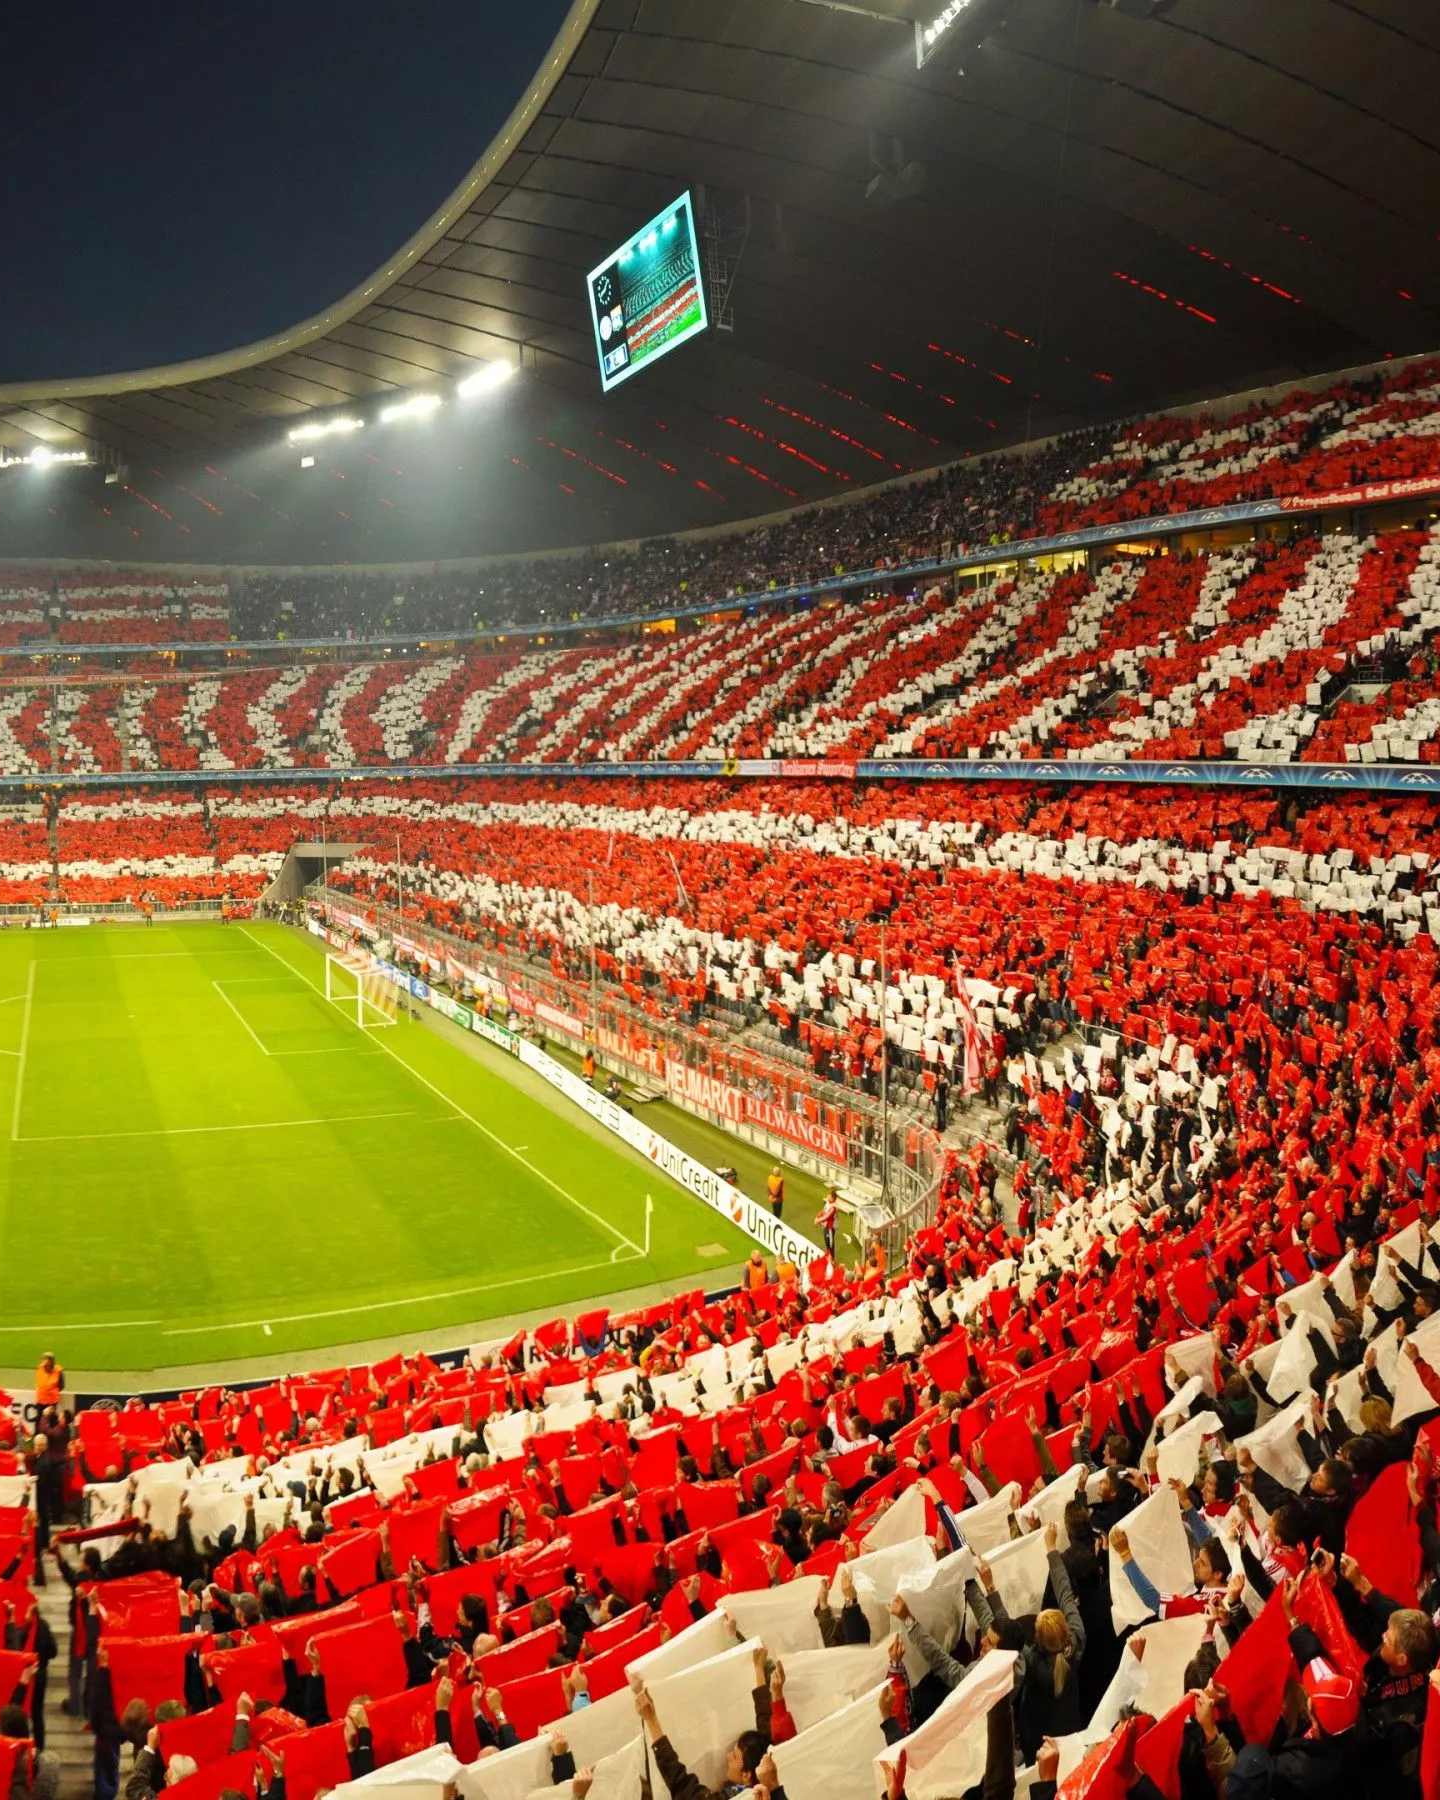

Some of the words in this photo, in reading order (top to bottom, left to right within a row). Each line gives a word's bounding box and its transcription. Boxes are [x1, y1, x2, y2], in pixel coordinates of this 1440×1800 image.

[1365, 485, 1389, 498] Bad
[665, 1058, 742, 1123] NEUMARKT
[745, 1100, 844, 1157] ELLWANGEN
[661, 1142, 721, 1206] UniCredit
[747, 1204, 820, 1268] UniCredi
